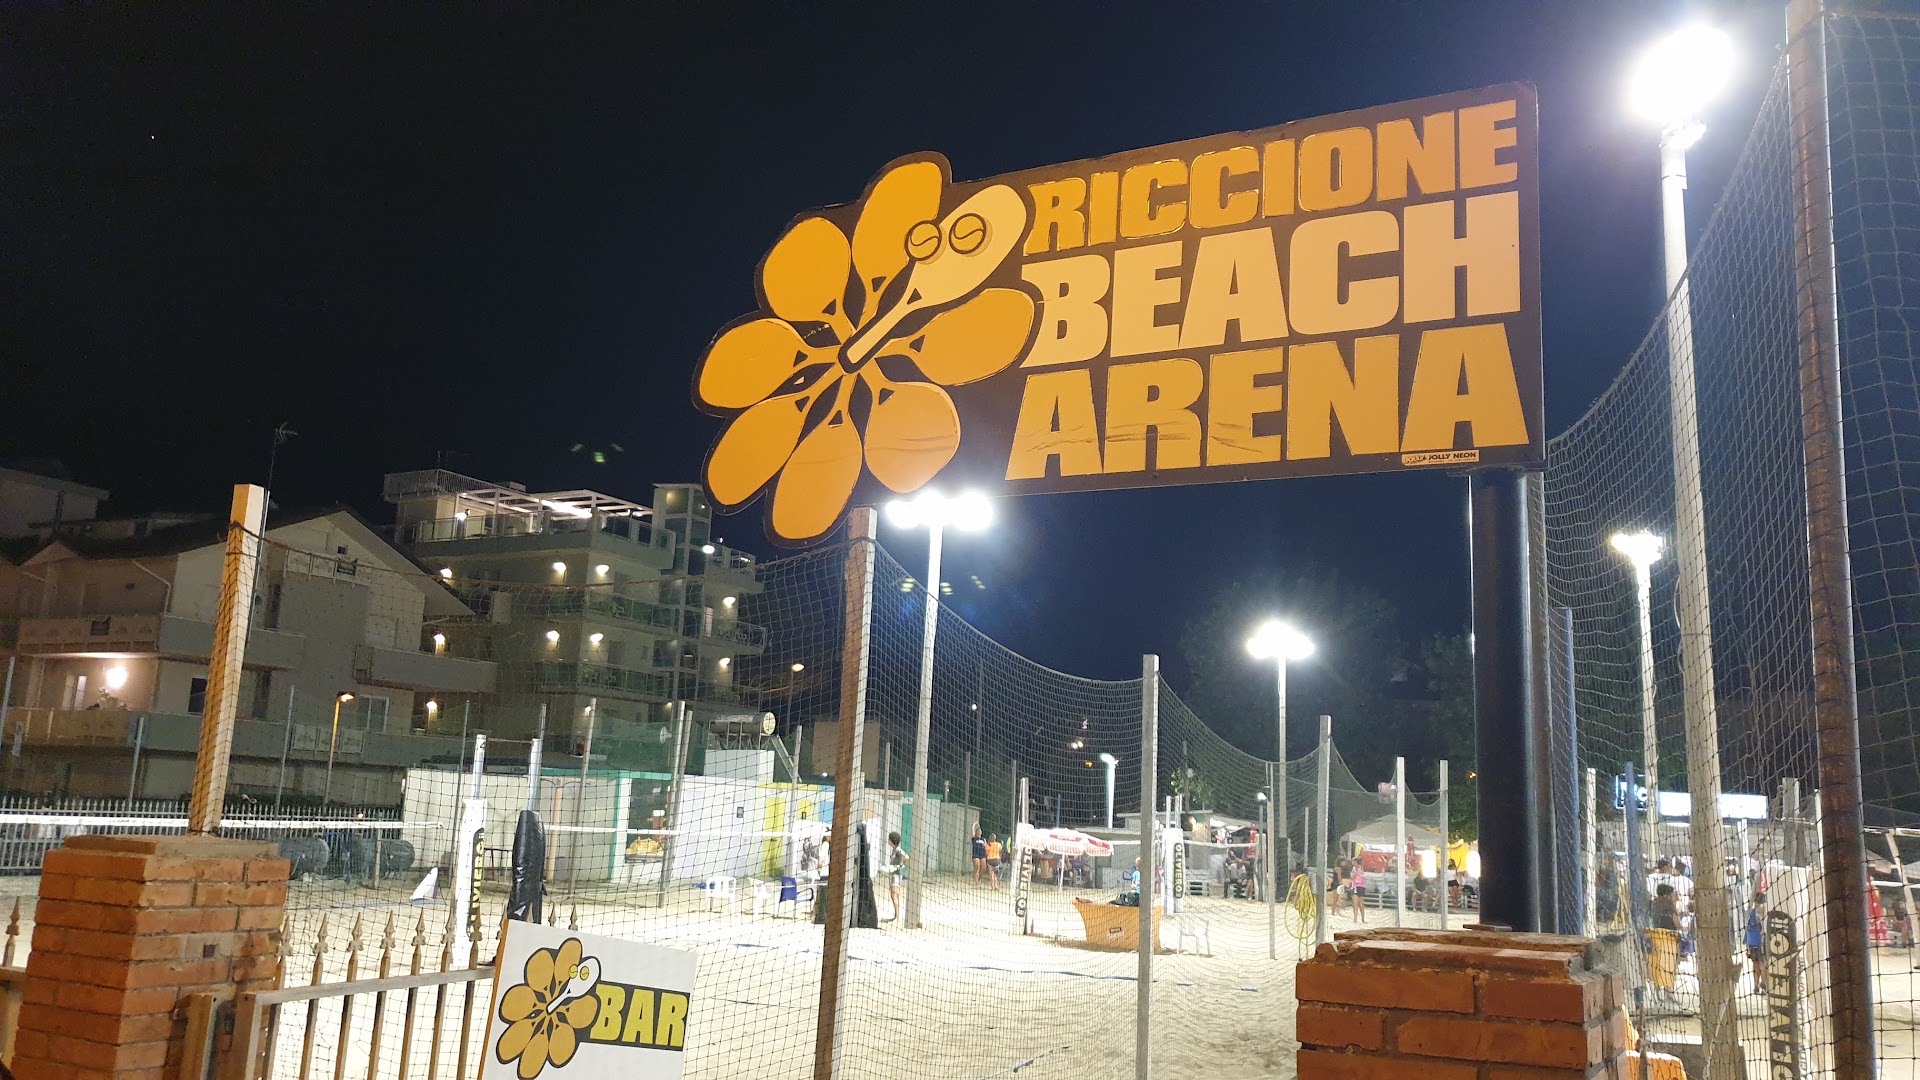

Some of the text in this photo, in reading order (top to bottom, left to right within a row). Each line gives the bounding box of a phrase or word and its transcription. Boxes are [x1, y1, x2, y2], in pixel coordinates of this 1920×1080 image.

[1023, 99, 1518, 256] RICCIONE
[1019, 191, 1521, 368] BEACH
[1005, 322, 1530, 481] ARENA
[589, 983, 688, 1047] BAR
